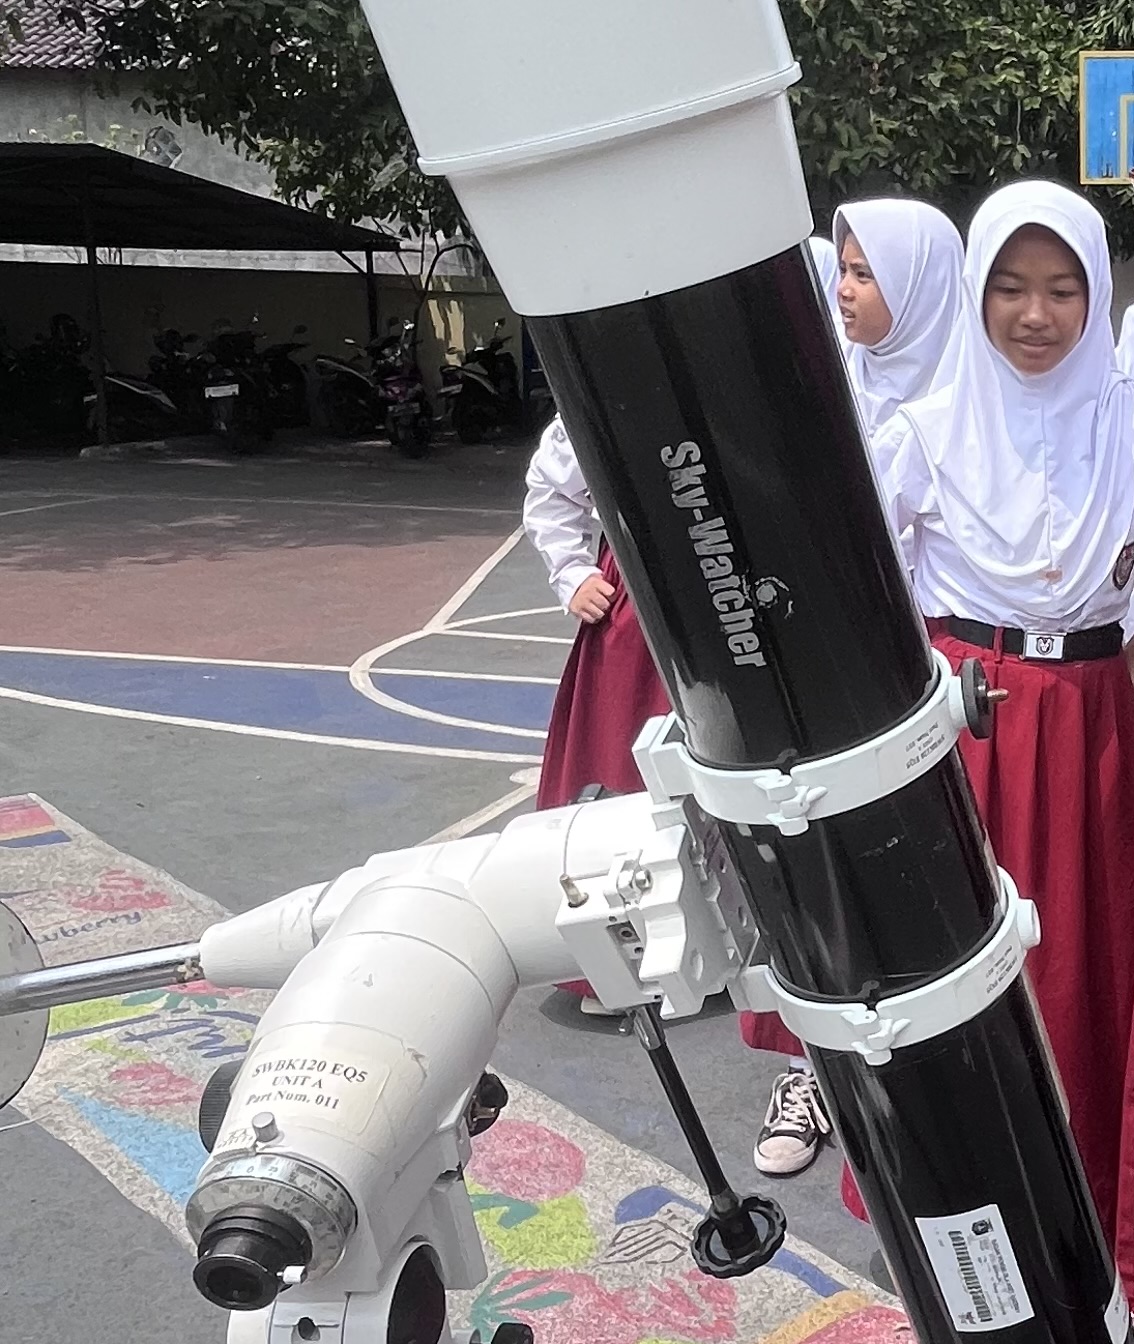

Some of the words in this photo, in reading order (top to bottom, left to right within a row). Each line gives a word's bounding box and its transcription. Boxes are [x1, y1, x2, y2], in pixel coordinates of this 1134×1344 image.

[660, 440, 768, 669] Sky-Watcher
[252, 1058, 327, 1078] SWBK120
[330, 1063, 369, 1084] EQ5
[272, 1075, 311, 1087] UNIT
[311, 1078, 323, 1089] A
[246, 1090, 272, 1106] Part
[274, 1090, 310, 1104] Num.
[315, 1094, 340, 1110] 011
